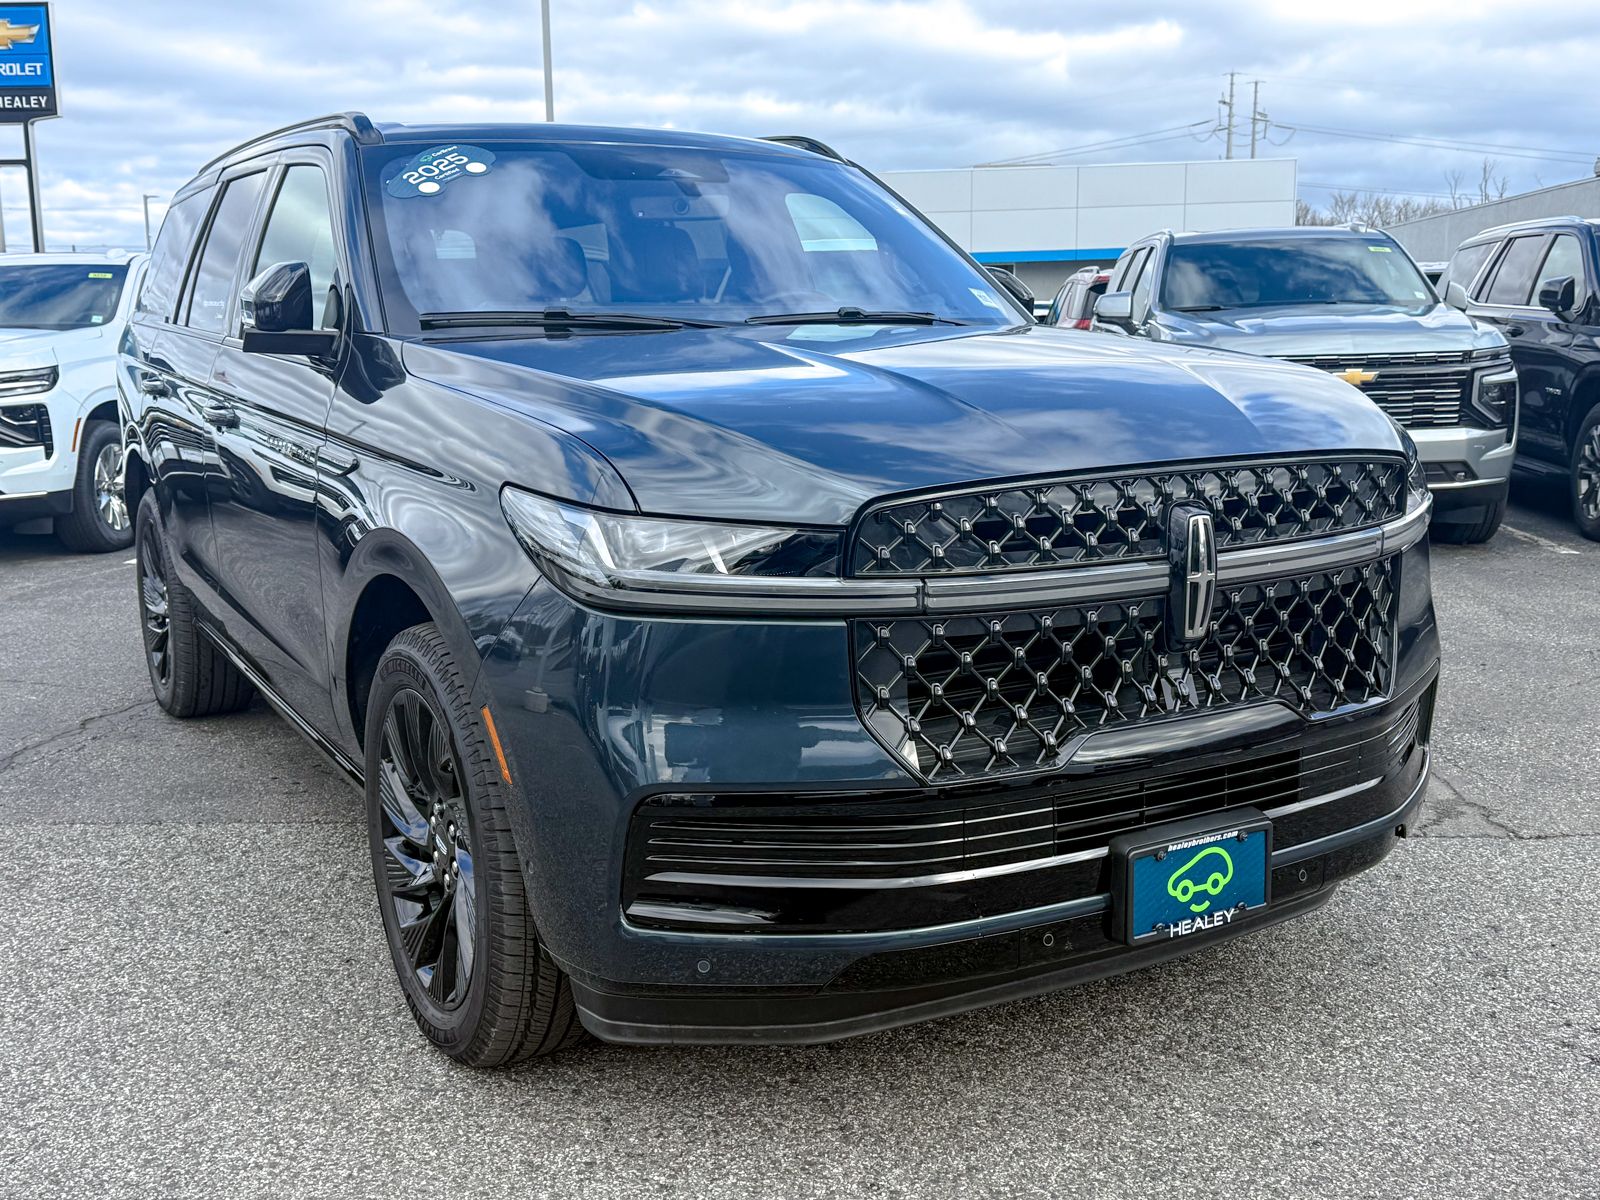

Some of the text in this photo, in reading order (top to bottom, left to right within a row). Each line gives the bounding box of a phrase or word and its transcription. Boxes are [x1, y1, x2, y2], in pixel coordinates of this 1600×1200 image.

[403, 153, 468, 184] 2025
[1167, 830, 1239, 852] healeybrothers.com
[1169, 908, 1236, 938] HEALEY
